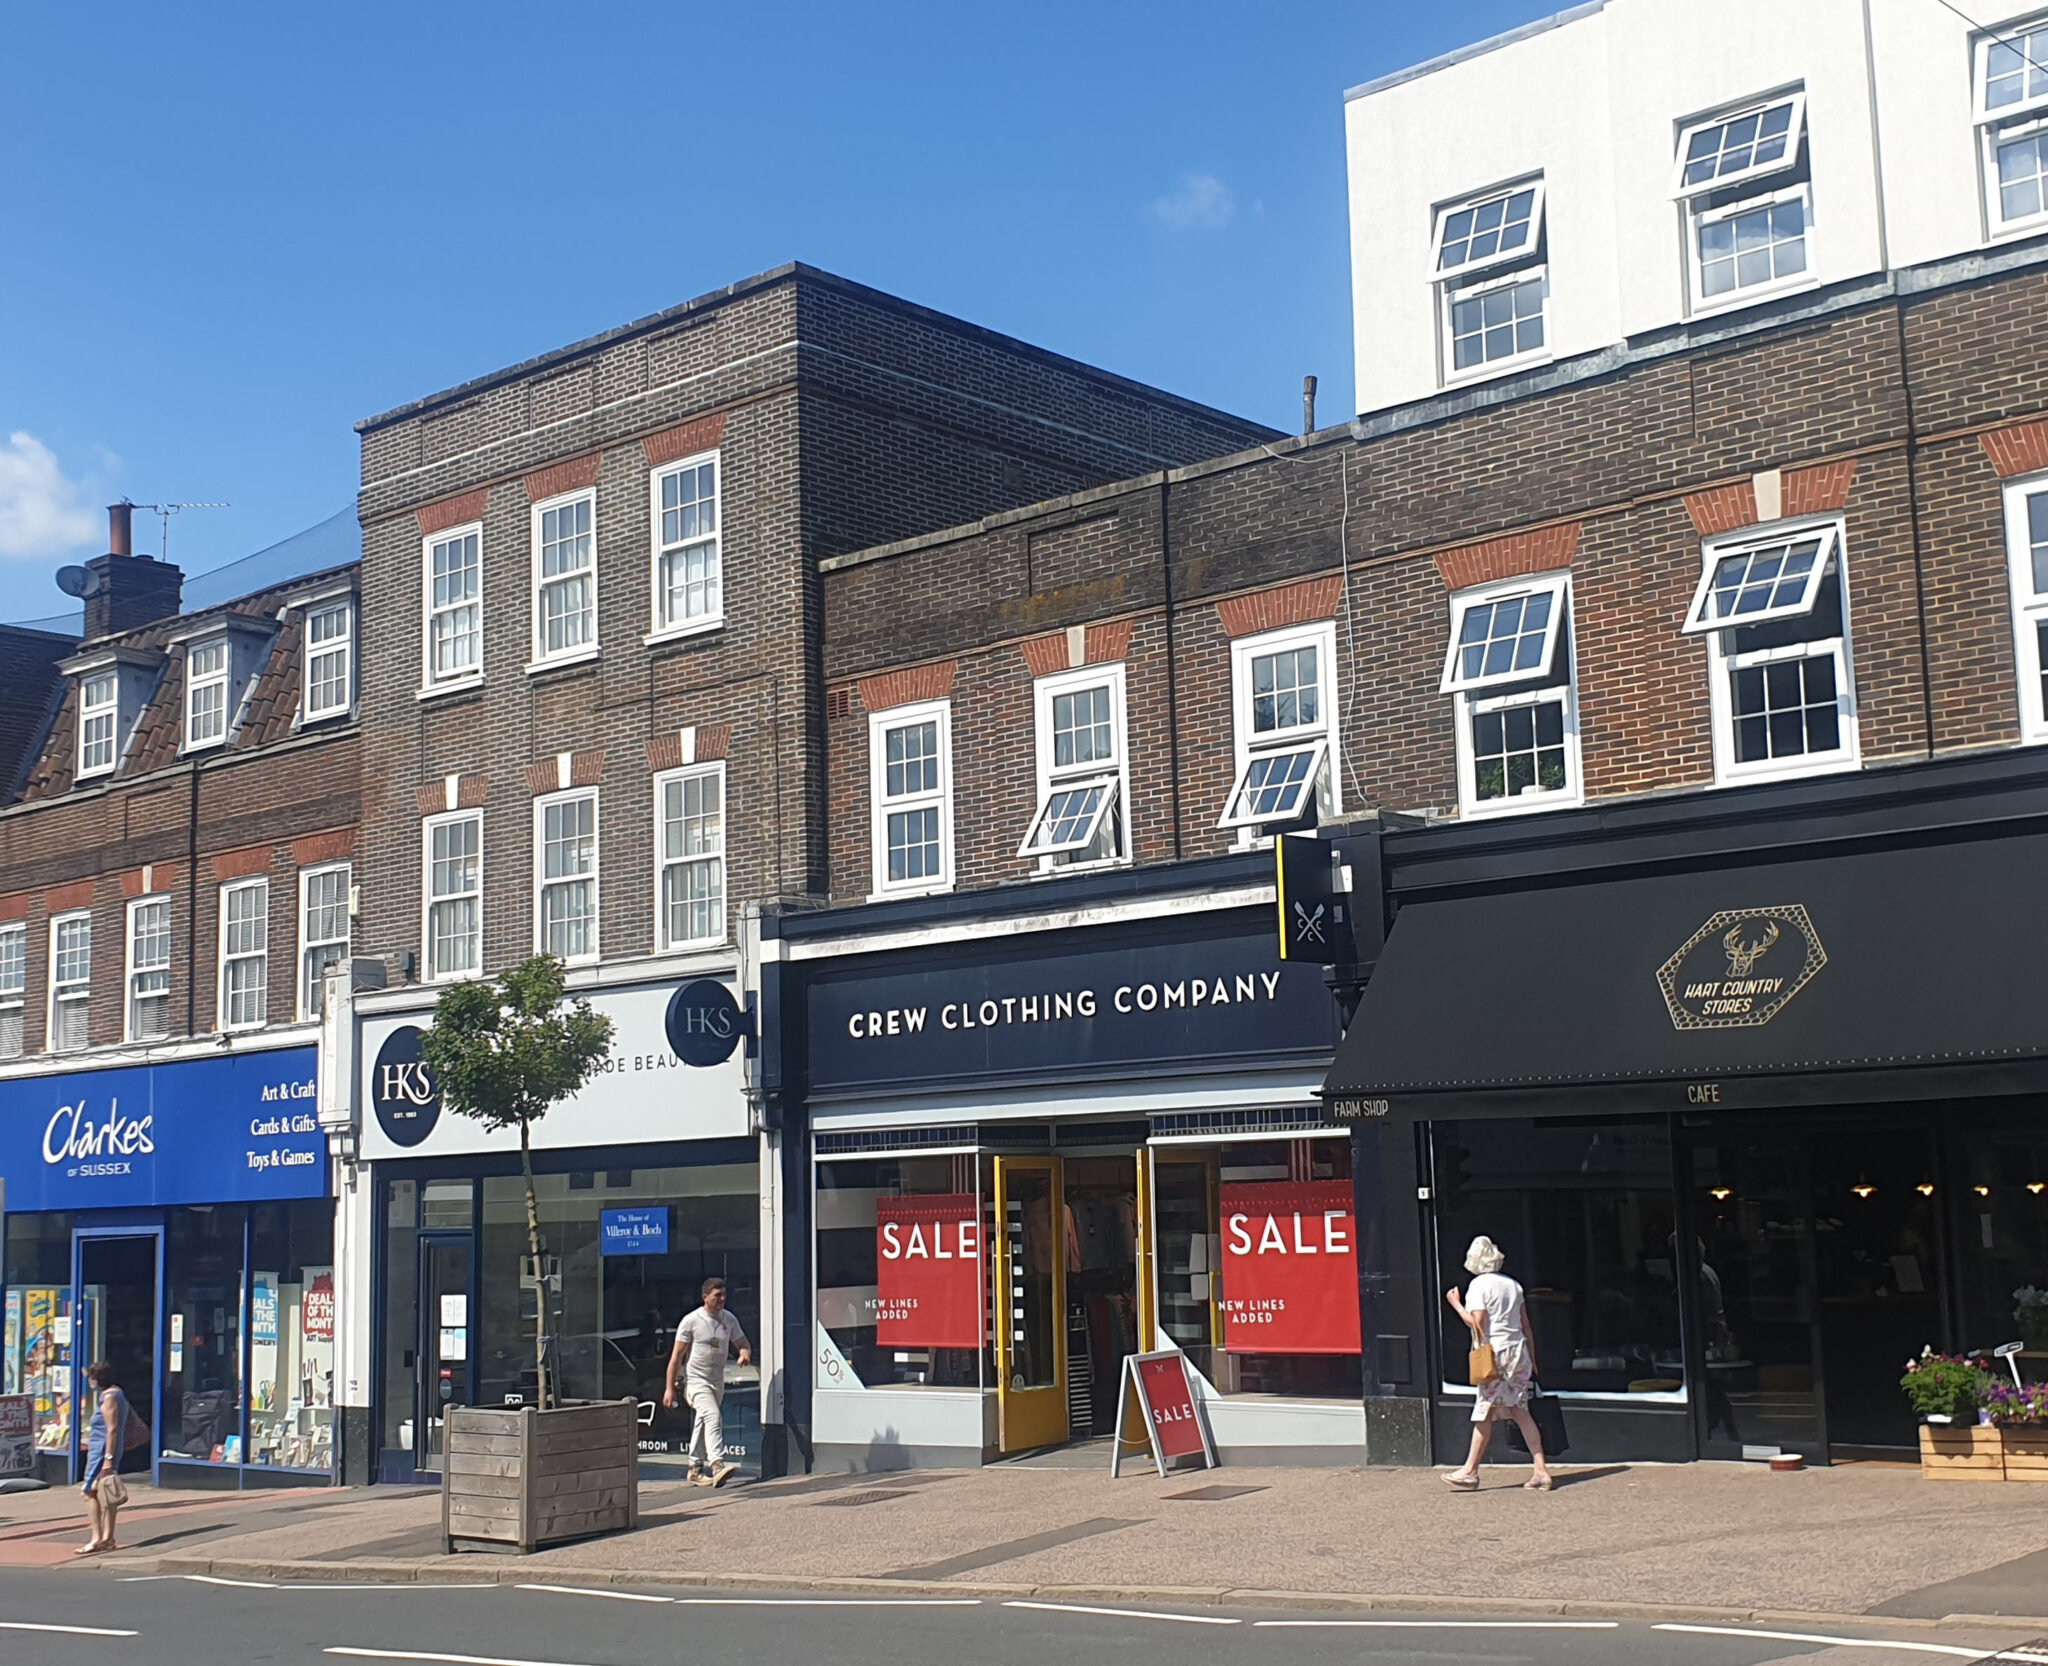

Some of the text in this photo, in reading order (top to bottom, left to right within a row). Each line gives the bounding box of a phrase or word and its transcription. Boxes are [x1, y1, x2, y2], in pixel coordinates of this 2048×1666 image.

[1684, 977, 1783, 998] HART COUNTRY
[849, 971, 1280, 1038] CREW CLOTHING COMPANY
[1702, 998, 1752, 1015] STORES
[685, 1007, 735, 1039] HKS
[261, 1079, 315, 1101] Art & Craft
[381, 1061, 435, 1105] HKS
[1688, 1084, 1720, 1103] CAFE
[1334, 1099, 1388, 1117] FARM SHOP
[42, 1097, 154, 1164] Clarkes
[251, 1114, 316, 1136] Cards & Gifts
[80, 1162, 131, 1176] SUSSEX
[246, 1148, 315, 1172] Toys & Games
[633, 1224, 639, 1236] &
[642, 1223, 662, 1235] Boch
[1229, 1210, 1350, 1256] SALE
[882, 1221, 978, 1259] SALE
[253, 1298, 274, 1310] ALS
[308, 1292, 334, 1305] DEAL
[865, 1298, 918, 1309] NEW LINES
[1218, 1299, 1285, 1311] NEW LINES
[320, 1305, 333, 1317] TH
[875, 1310, 908, 1319] ADDED
[1232, 1312, 1273, 1323] ADDED
[306, 1317, 333, 1329] MONT
[1153, 1403, 1193, 1424] SALE
[722, 1445, 746, 1456] ACES
